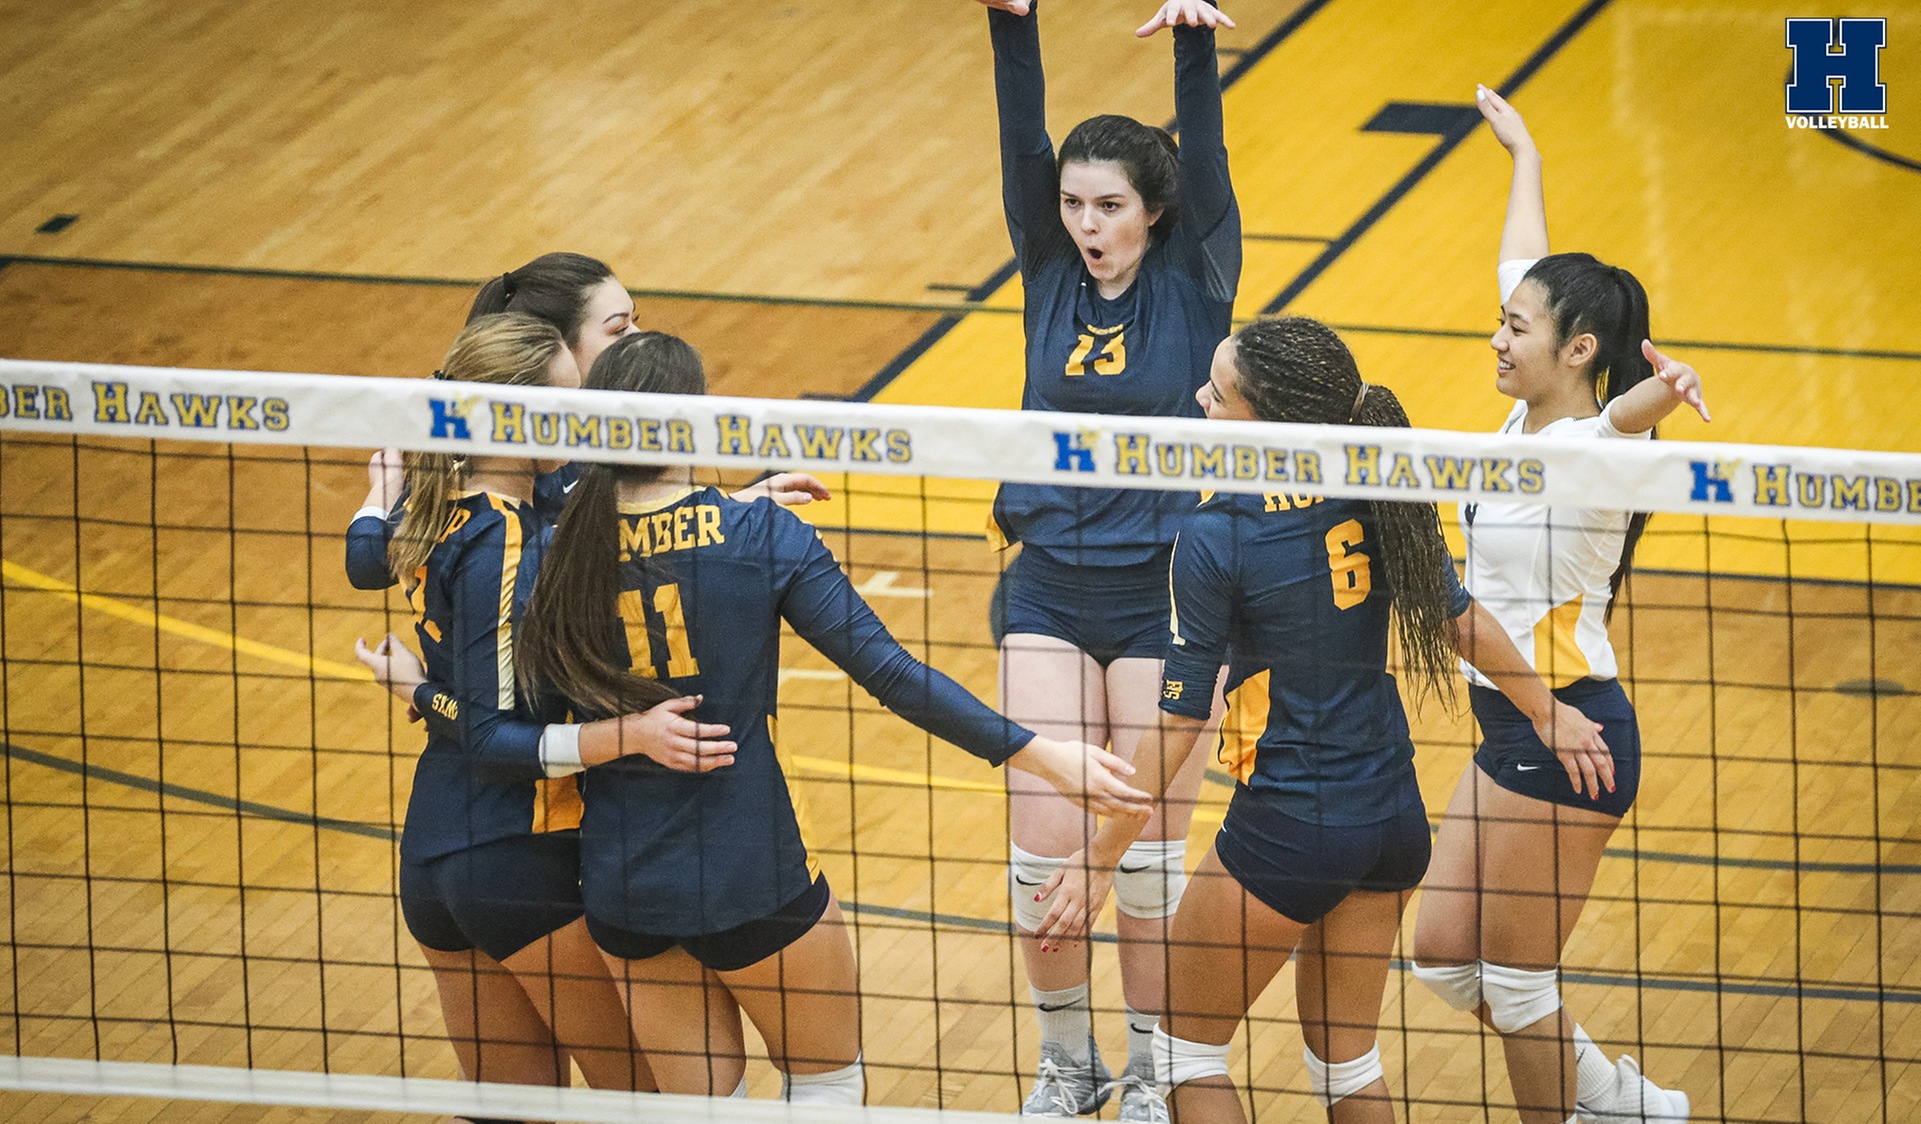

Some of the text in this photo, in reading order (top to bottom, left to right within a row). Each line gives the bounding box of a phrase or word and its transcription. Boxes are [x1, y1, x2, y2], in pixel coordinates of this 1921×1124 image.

[0, 380, 290, 432] ER HAWKS
[489, 399, 694, 453] HUMBER
[716, 413, 913, 463] HAWKS
[1113, 433, 1323, 485] HUMBER
[1344, 443, 1546, 495] HAWKS
[1325, 518, 1371, 611] 6
[616, 582, 700, 679] 11
